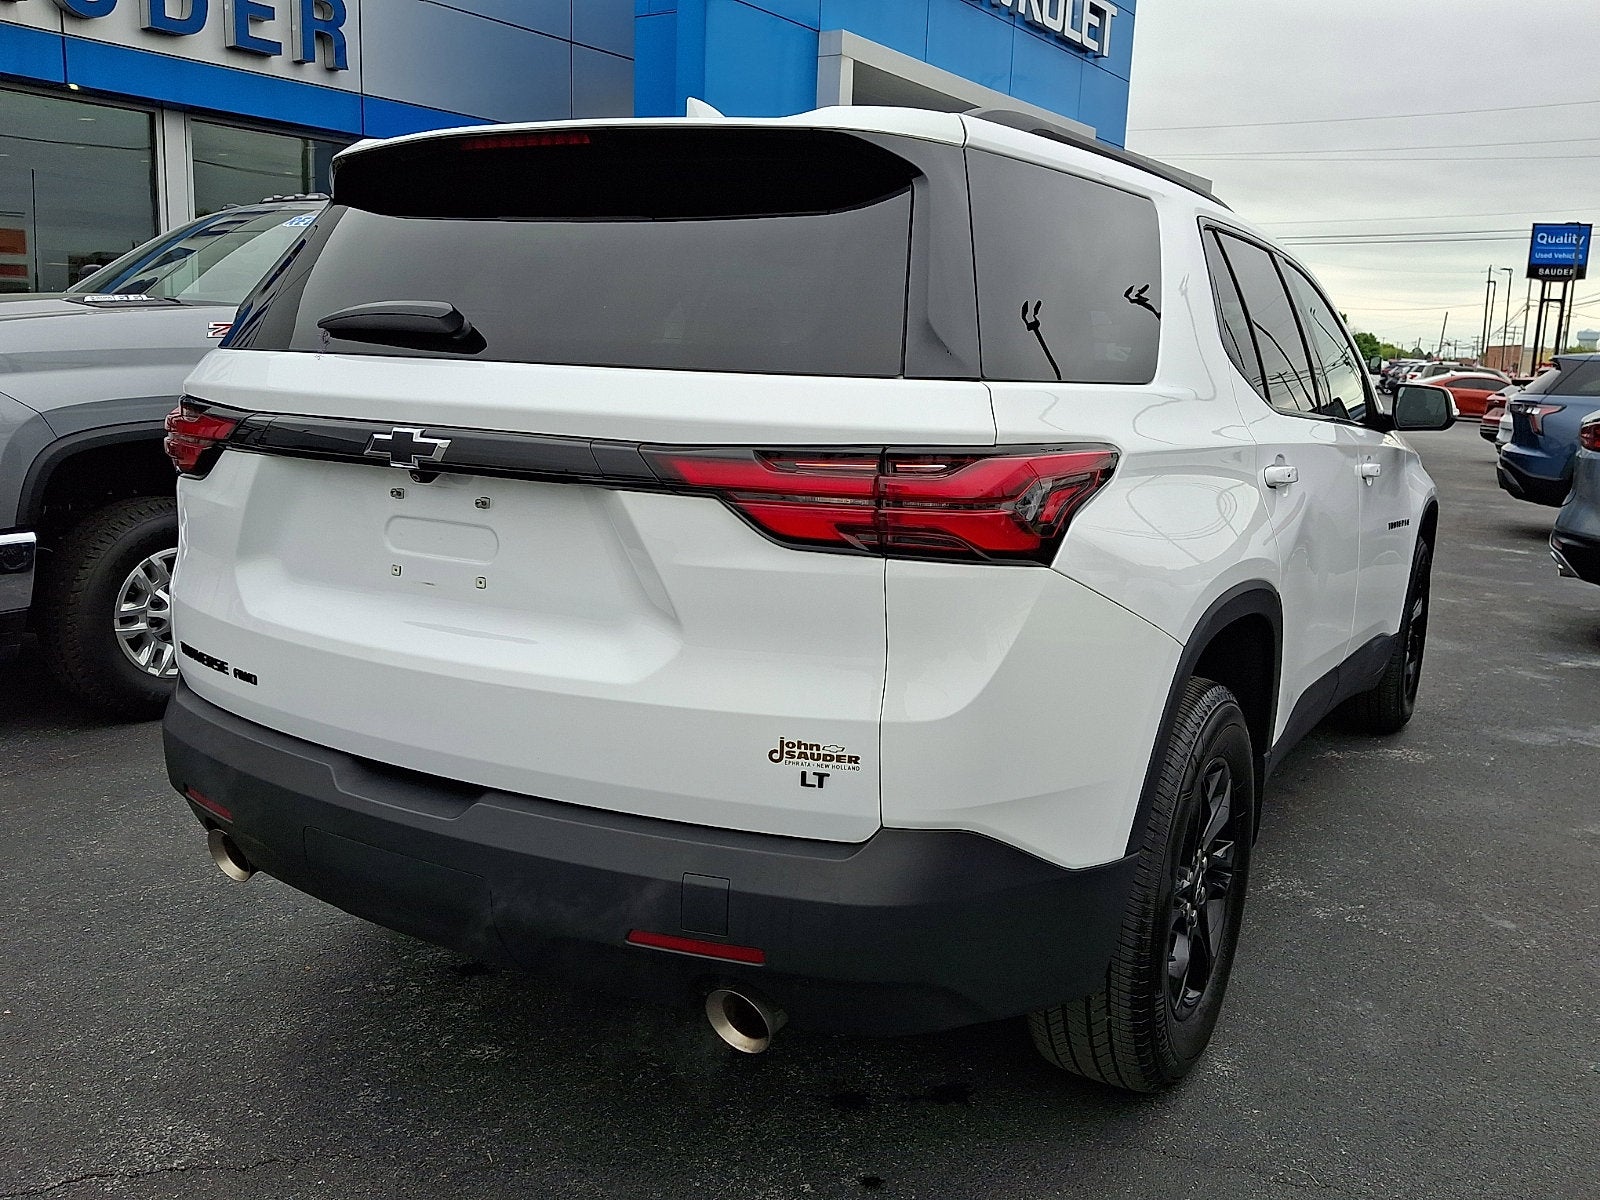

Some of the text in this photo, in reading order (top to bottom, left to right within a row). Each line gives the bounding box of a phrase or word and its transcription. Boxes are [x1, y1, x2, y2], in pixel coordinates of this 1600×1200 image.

[1536, 233, 1586, 246] Quality
[1553, 252, 1583, 260] Vehicls
[784, 750, 861, 765] SAUDER
[784, 759, 811, 768] EPHRATA
[831, 764, 861, 772] HOLLAND
[800, 770, 831, 789] LT
